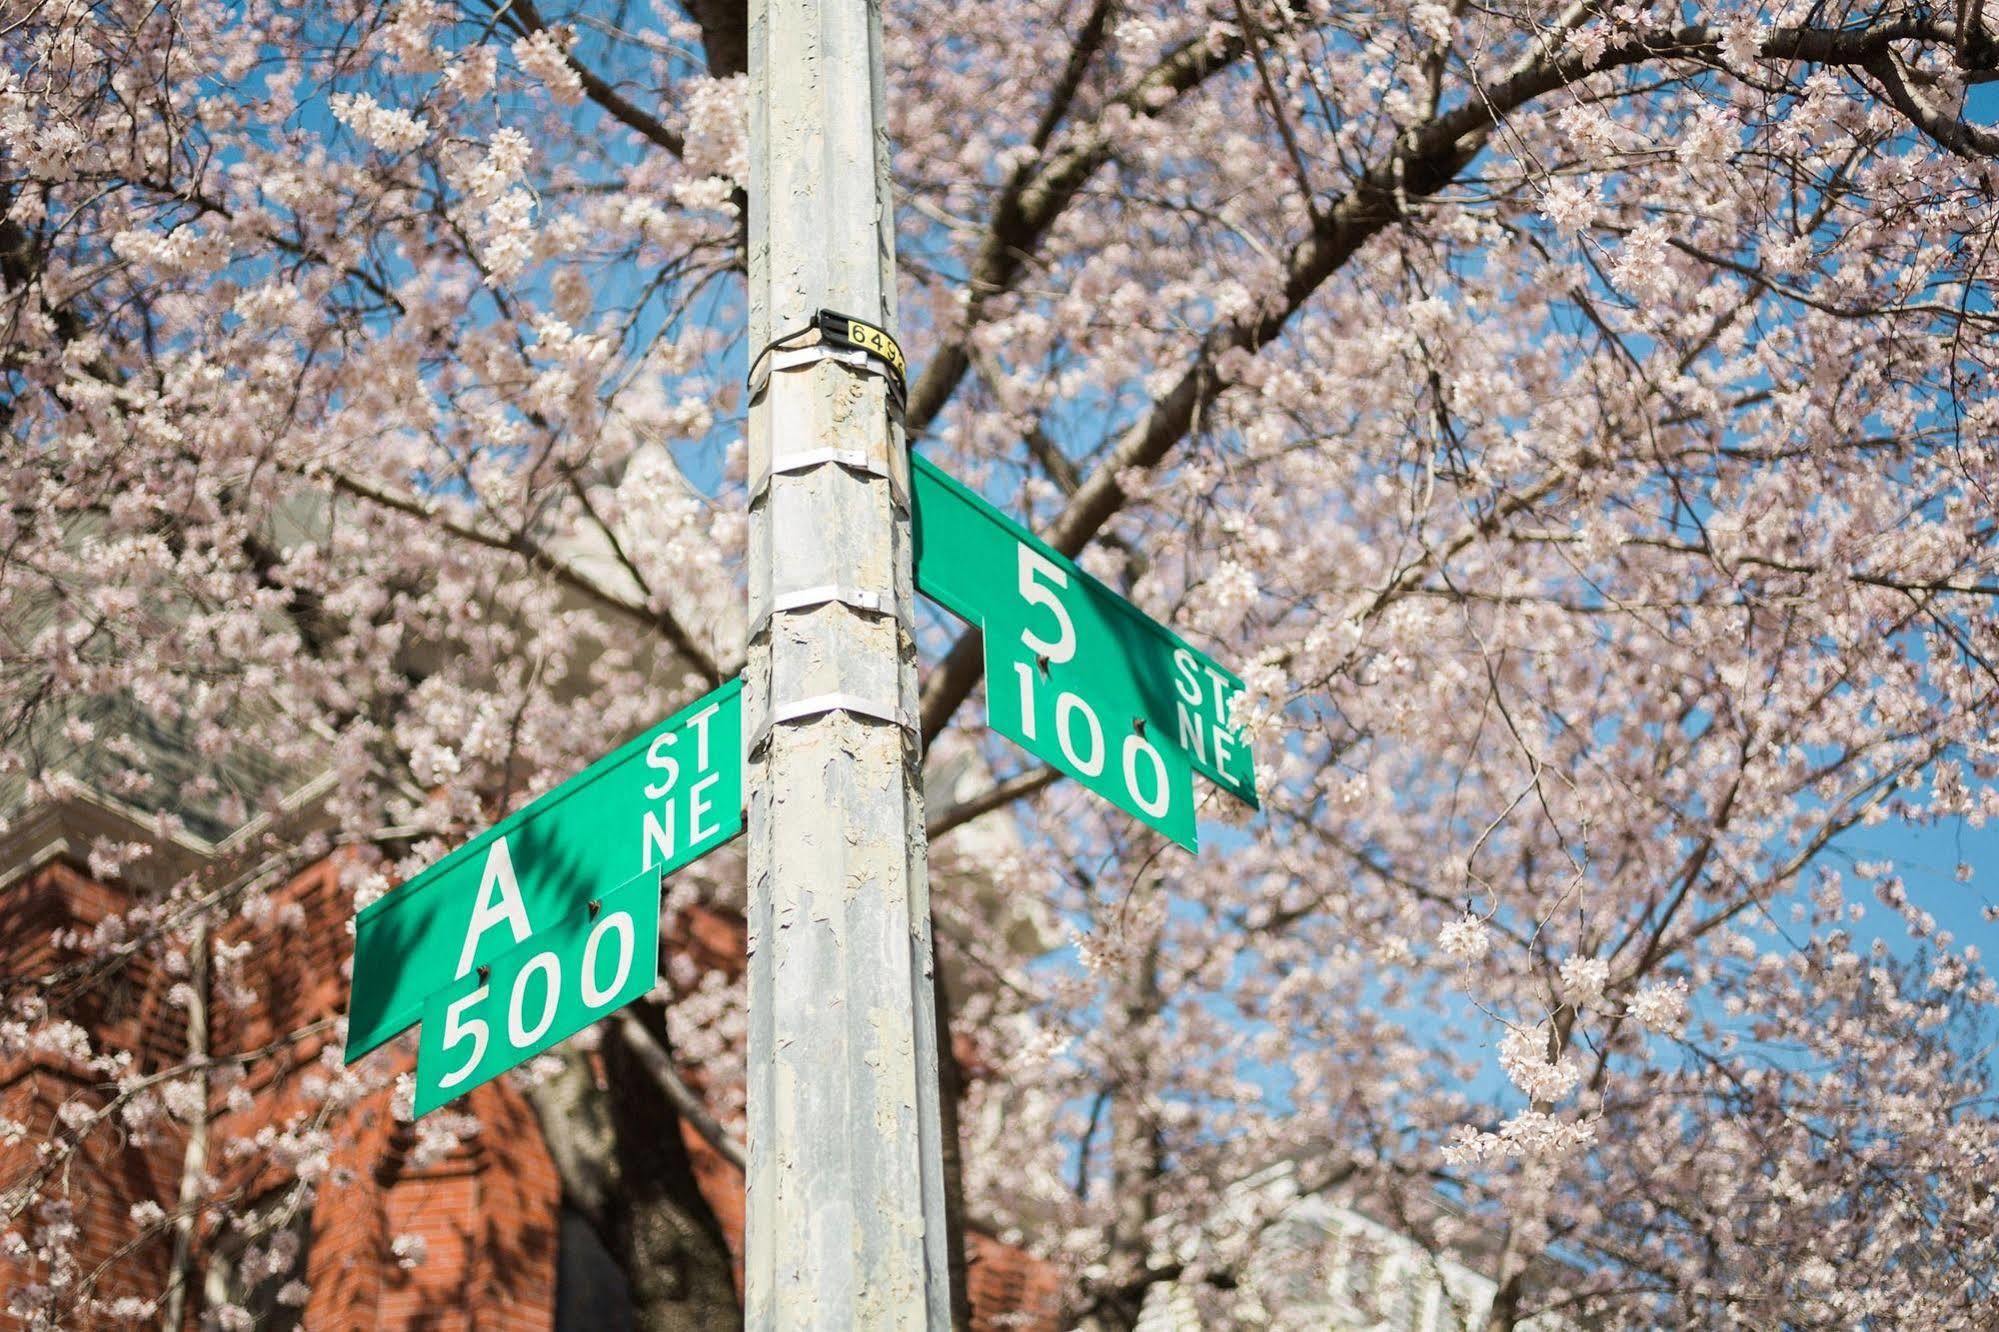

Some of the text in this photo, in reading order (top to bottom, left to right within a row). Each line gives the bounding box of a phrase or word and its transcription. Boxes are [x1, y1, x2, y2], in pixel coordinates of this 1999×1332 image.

[1018, 541, 1229, 724] 5 ST
[642, 771, 720, 873] NE
[1014, 661, 1170, 818] 100
[1177, 701, 1240, 787] NE
[454, 702, 720, 981] A ST
[438, 911, 635, 1088] 500
